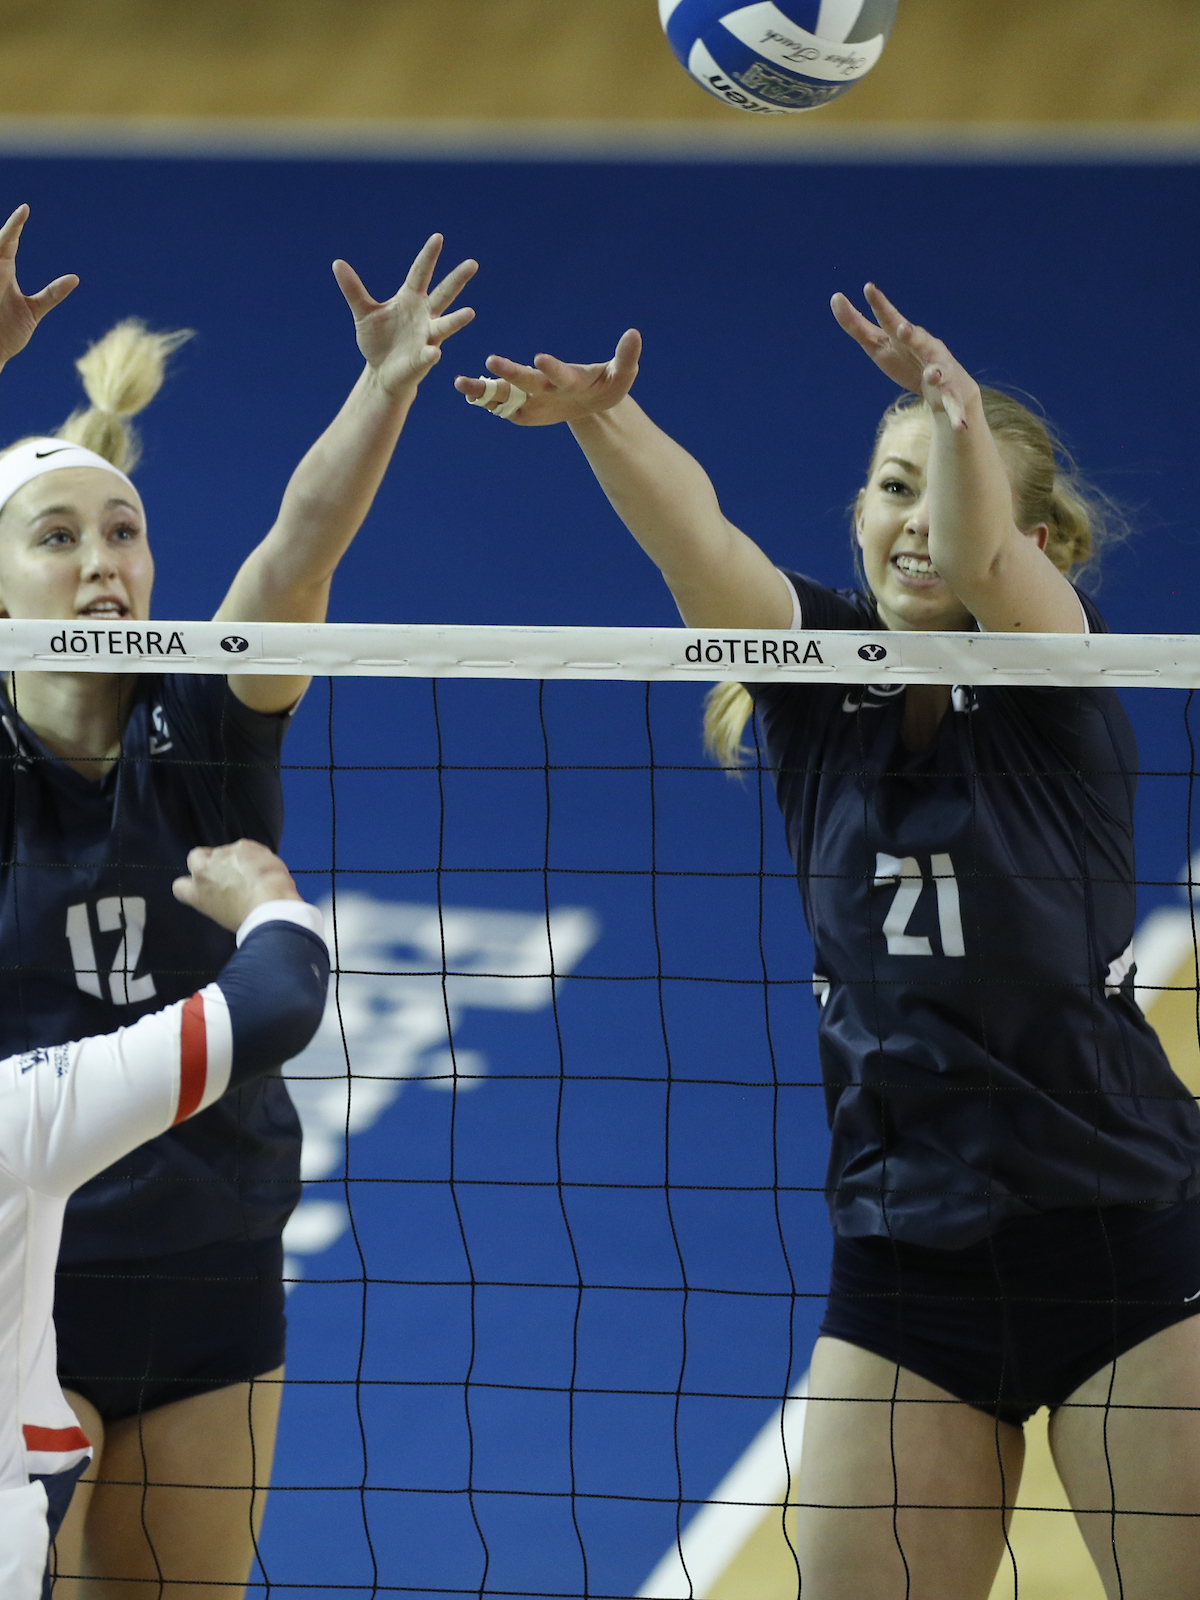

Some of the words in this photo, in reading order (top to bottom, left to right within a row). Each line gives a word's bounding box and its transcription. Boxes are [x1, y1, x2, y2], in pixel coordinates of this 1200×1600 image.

[758, 28, 821, 63] Touch
[708, 75, 786, 114] lten
[873, 852, 966, 957] 21
[65, 896, 157, 1005] 12
